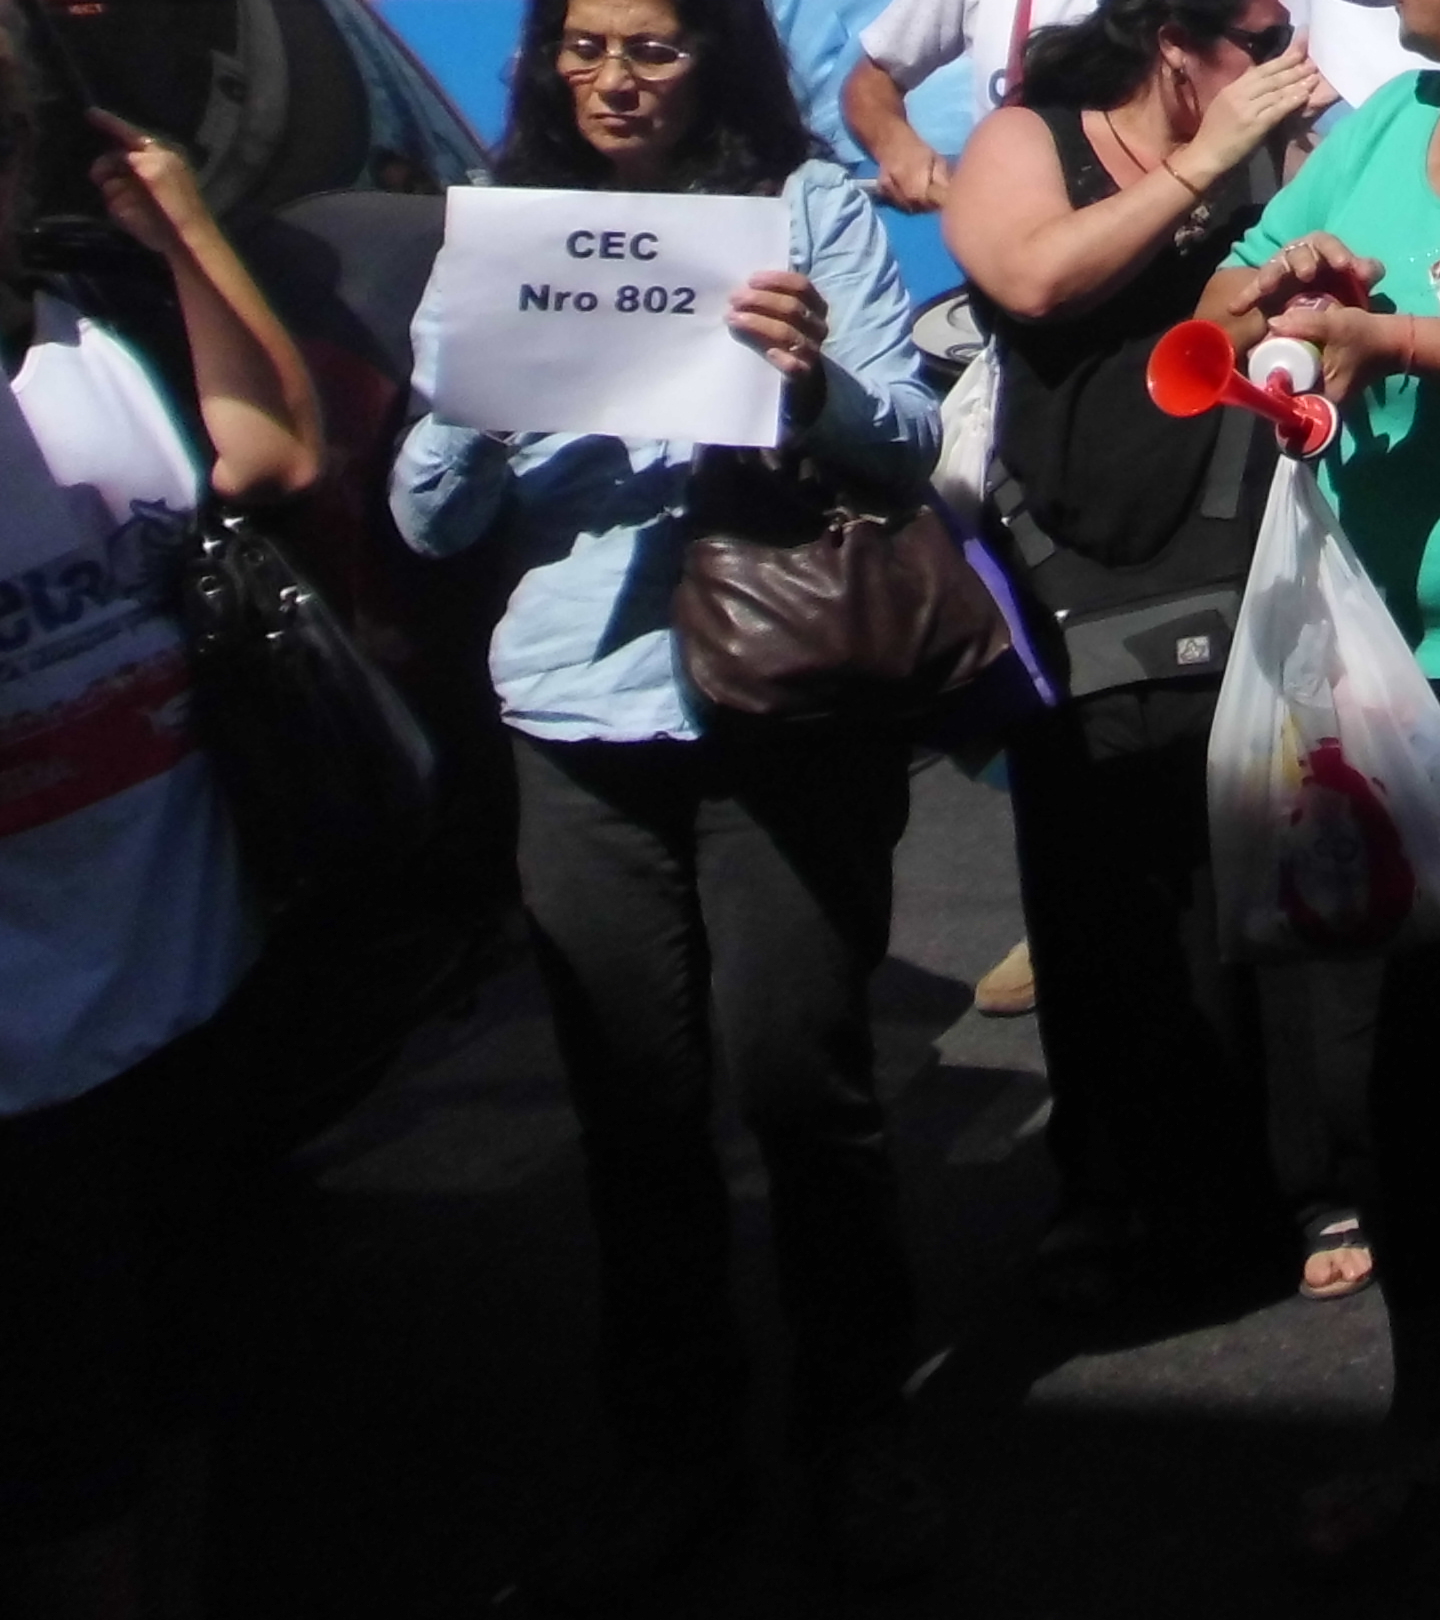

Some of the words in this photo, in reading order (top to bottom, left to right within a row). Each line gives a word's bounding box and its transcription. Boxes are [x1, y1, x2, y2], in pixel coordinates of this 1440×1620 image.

[565, 229, 659, 261] CEC
[519, 283, 597, 314] Nro
[614, 285, 695, 314] 802
